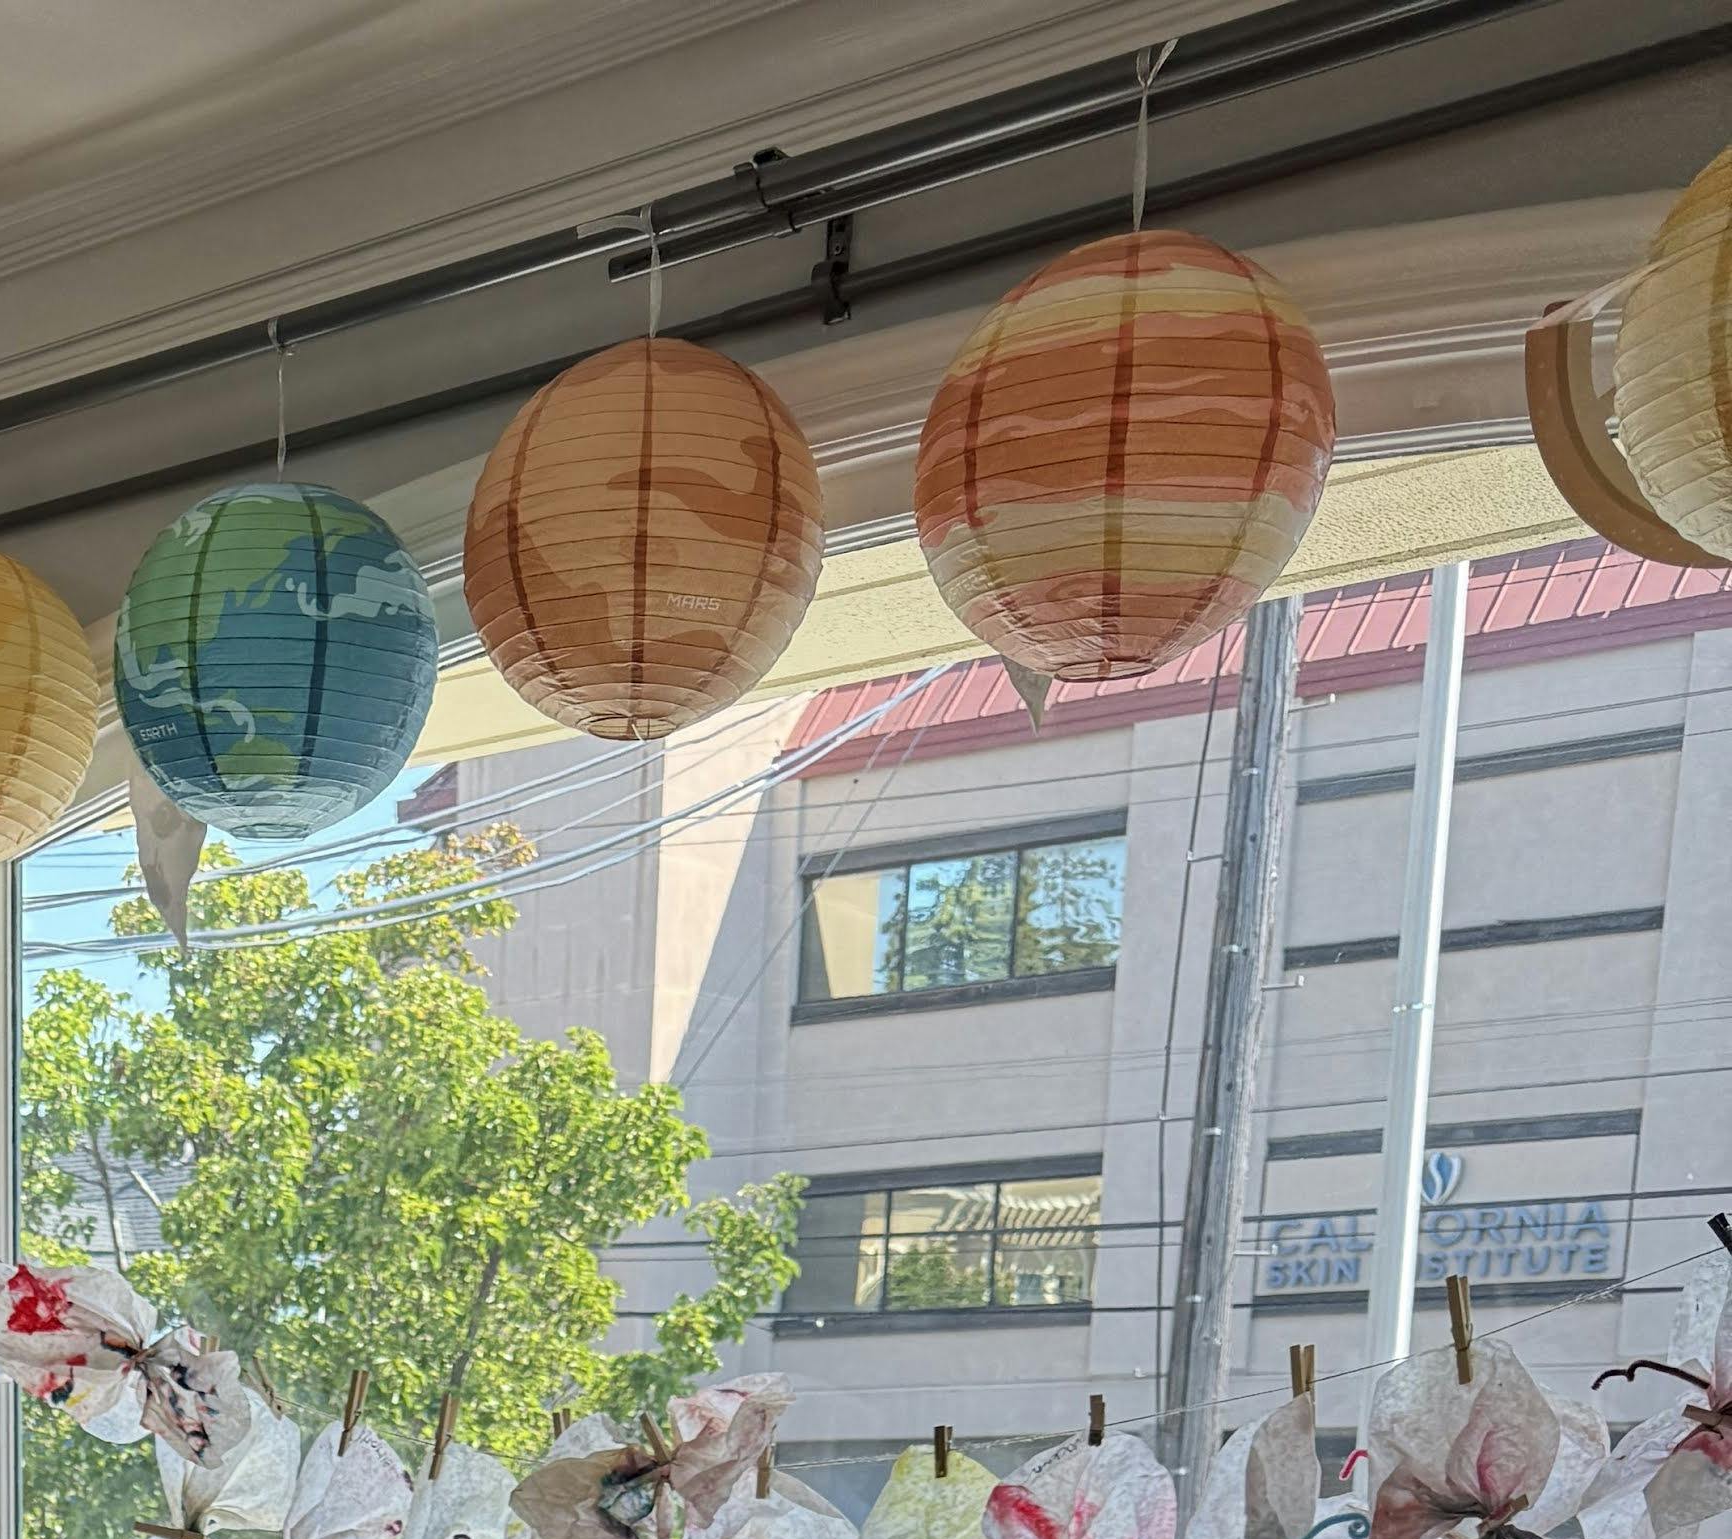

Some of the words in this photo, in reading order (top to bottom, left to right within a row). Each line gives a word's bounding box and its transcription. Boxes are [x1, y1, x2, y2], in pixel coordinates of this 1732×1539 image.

[667, 593, 722, 611] MARS
[140, 722, 179, 741] EARTH
[1269, 1203, 1611, 1256] CALORNIA
[1268, 1257, 1361, 1289] SKIN
[1417, 1244, 1611, 1281] STITUTE
